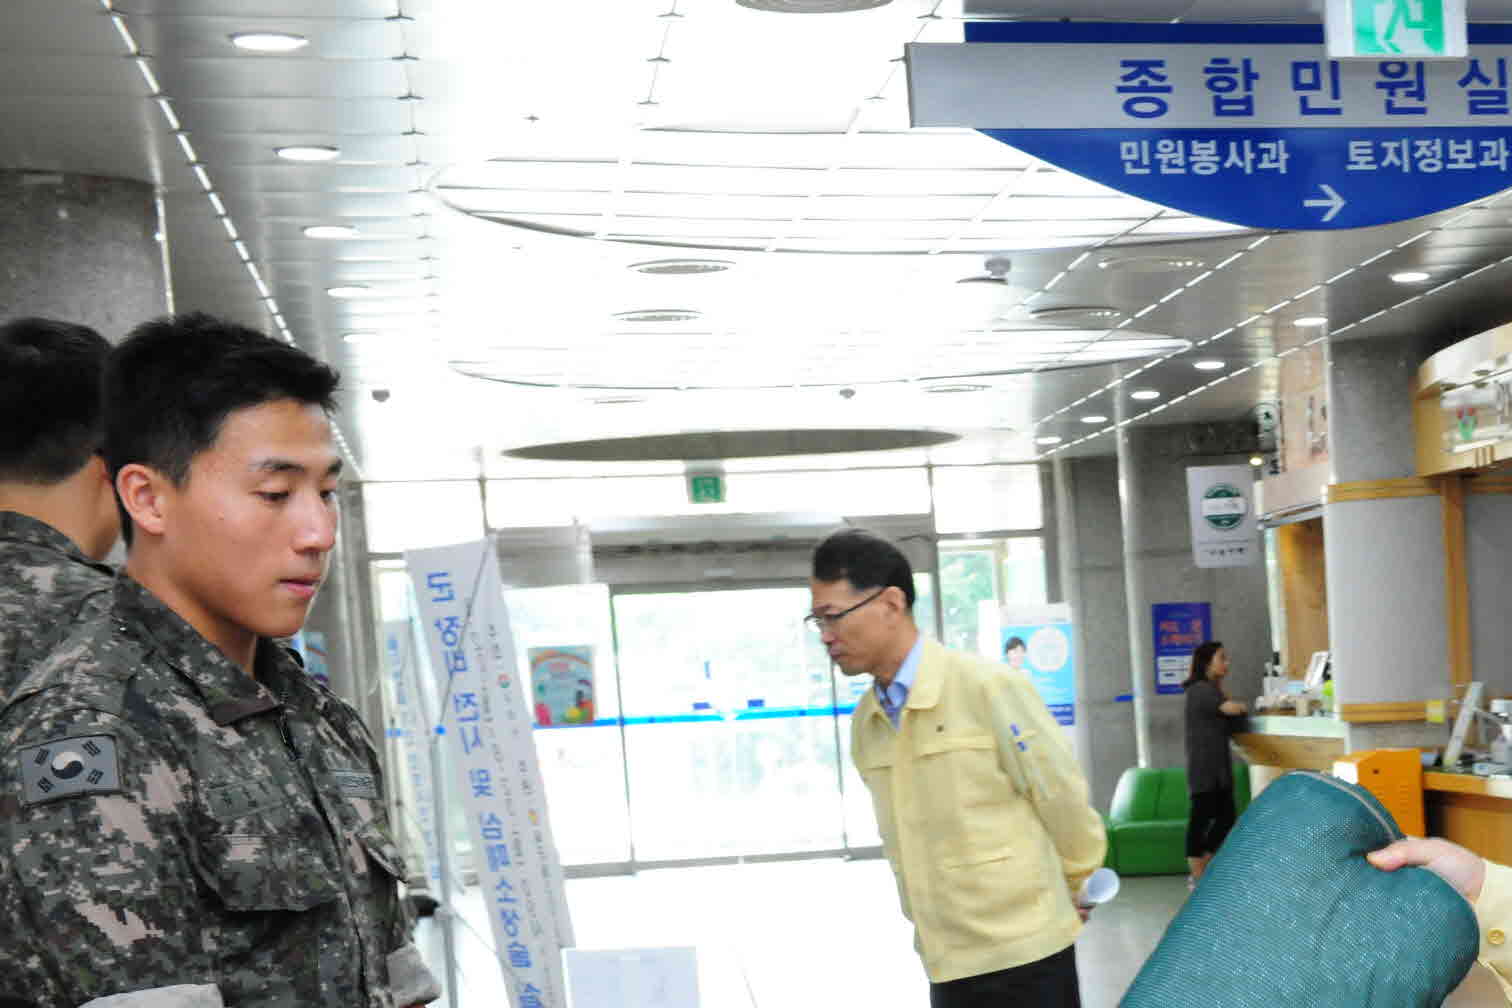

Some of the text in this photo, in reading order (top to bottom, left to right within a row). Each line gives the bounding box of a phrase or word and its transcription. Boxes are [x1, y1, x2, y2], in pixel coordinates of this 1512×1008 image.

[1115, 58, 1510, 119] 종합민원실
[1121, 139, 1508, 174] 민원봉사과 토지정보과
